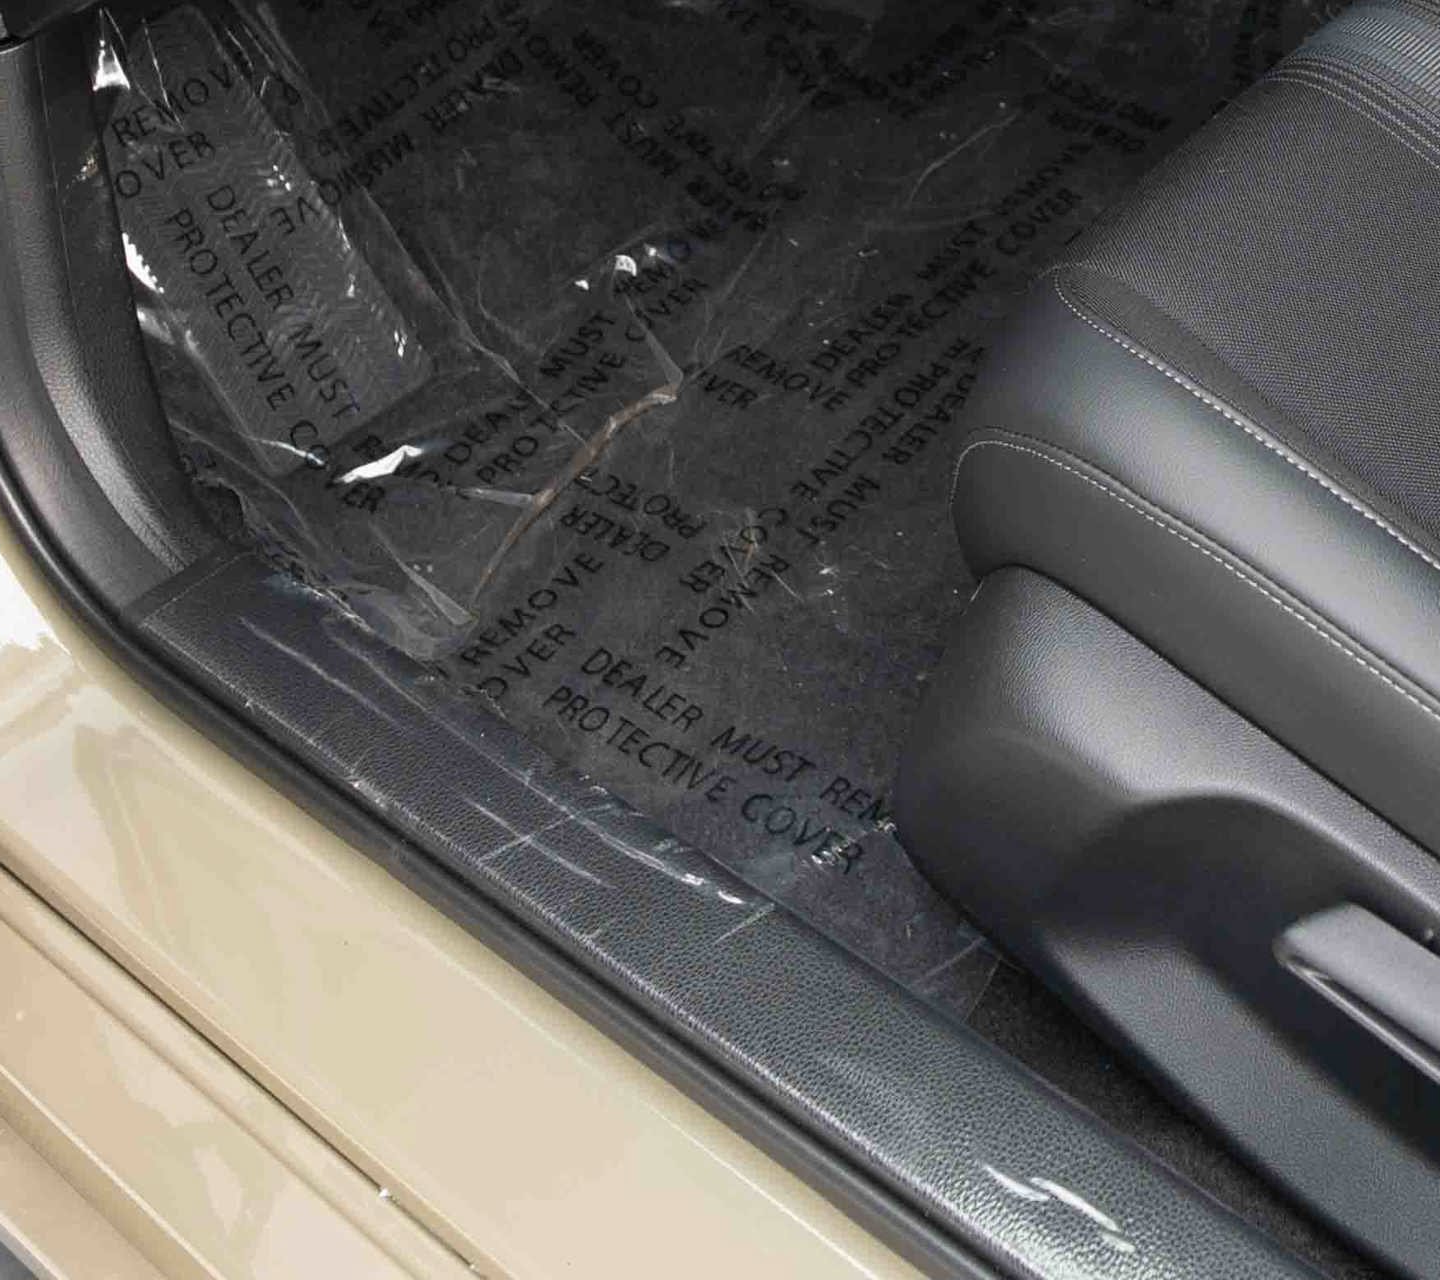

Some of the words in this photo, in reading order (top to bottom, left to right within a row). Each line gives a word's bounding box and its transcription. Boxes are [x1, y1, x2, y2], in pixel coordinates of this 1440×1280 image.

[165, 208, 296, 411] PROTECTIVE
[208, 185, 295, 311] DEALER
[288, 326, 360, 418] MUST
[541, 307, 614, 384] MUST
[809, 285, 914, 378] DEALER
[913, 219, 985, 284] MUST
[841, 254, 998, 391] PROTECTIVE
[723, 337, 848, 416] REMOVE
[788, 356, 954, 505] PROTECTIVE
[560, 503, 669, 565] DEALER
[794, 471, 882, 547] MUST
[460, 546, 604, 672] REMOVE
[652, 549, 791, 672] REMOVE
[542, 680, 731, 807] PROTECTIVE
[738, 786, 864, 877] COVER
[579, 644, 706, 735] DEALER
[710, 715, 816, 794] MUST
